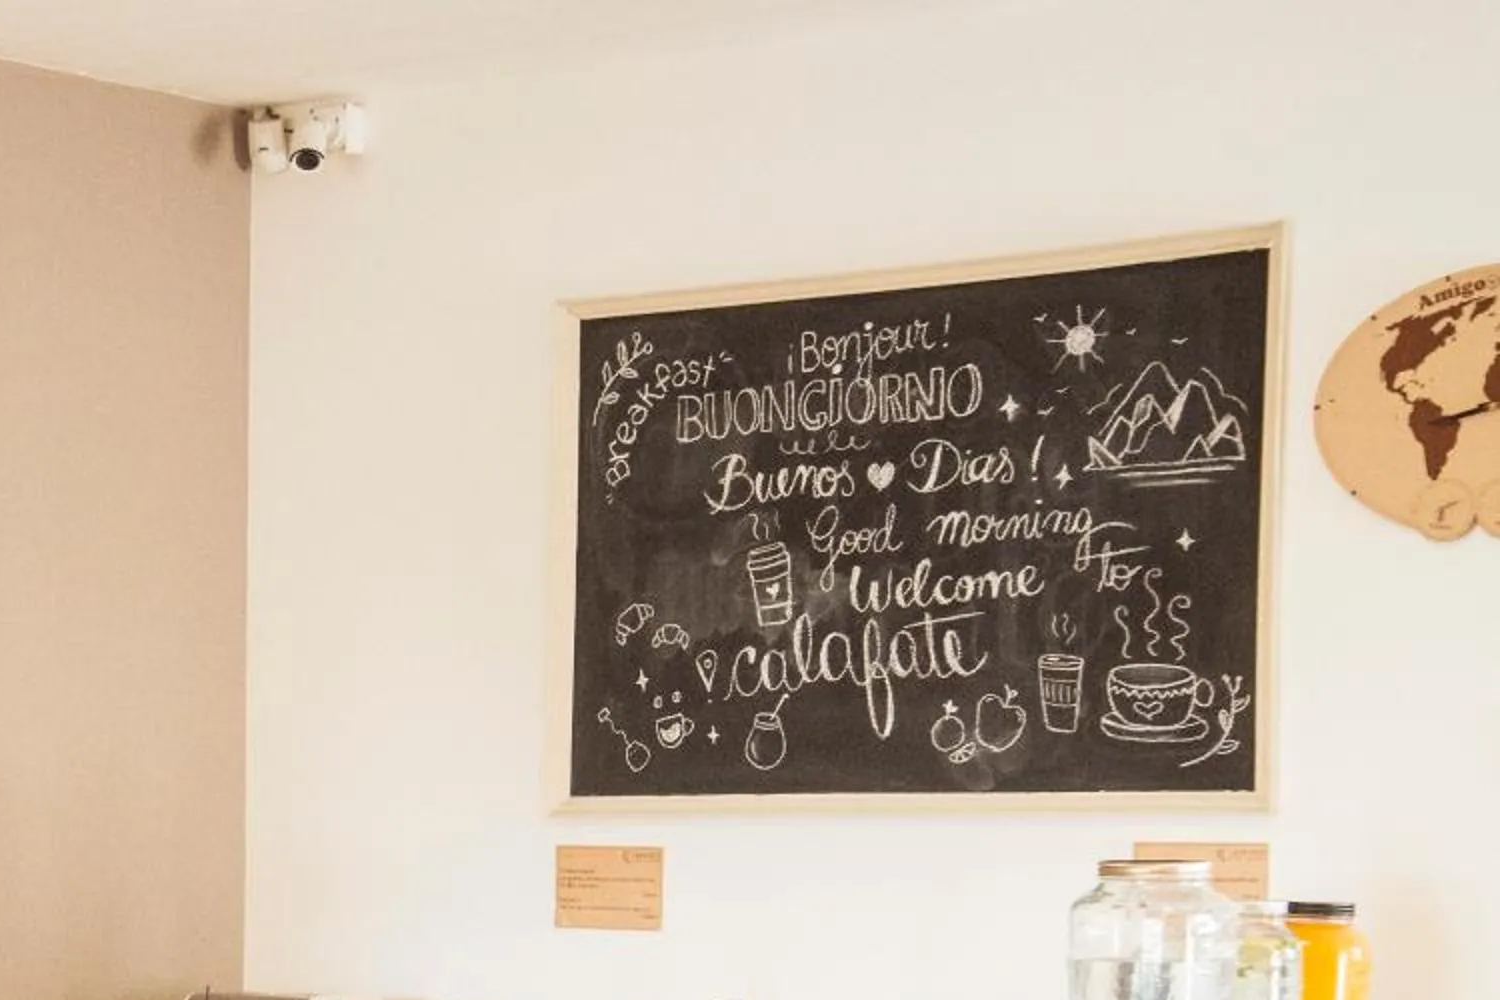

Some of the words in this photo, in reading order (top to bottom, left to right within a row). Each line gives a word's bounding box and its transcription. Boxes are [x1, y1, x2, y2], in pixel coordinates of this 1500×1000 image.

[674, 363, 983, 444] BUONGIORNO
[703, 452, 856, 515] Buenos
[805, 503, 904, 593] Good
[925, 498, 1138, 573] morning
[1077, 540, 1151, 593] to
